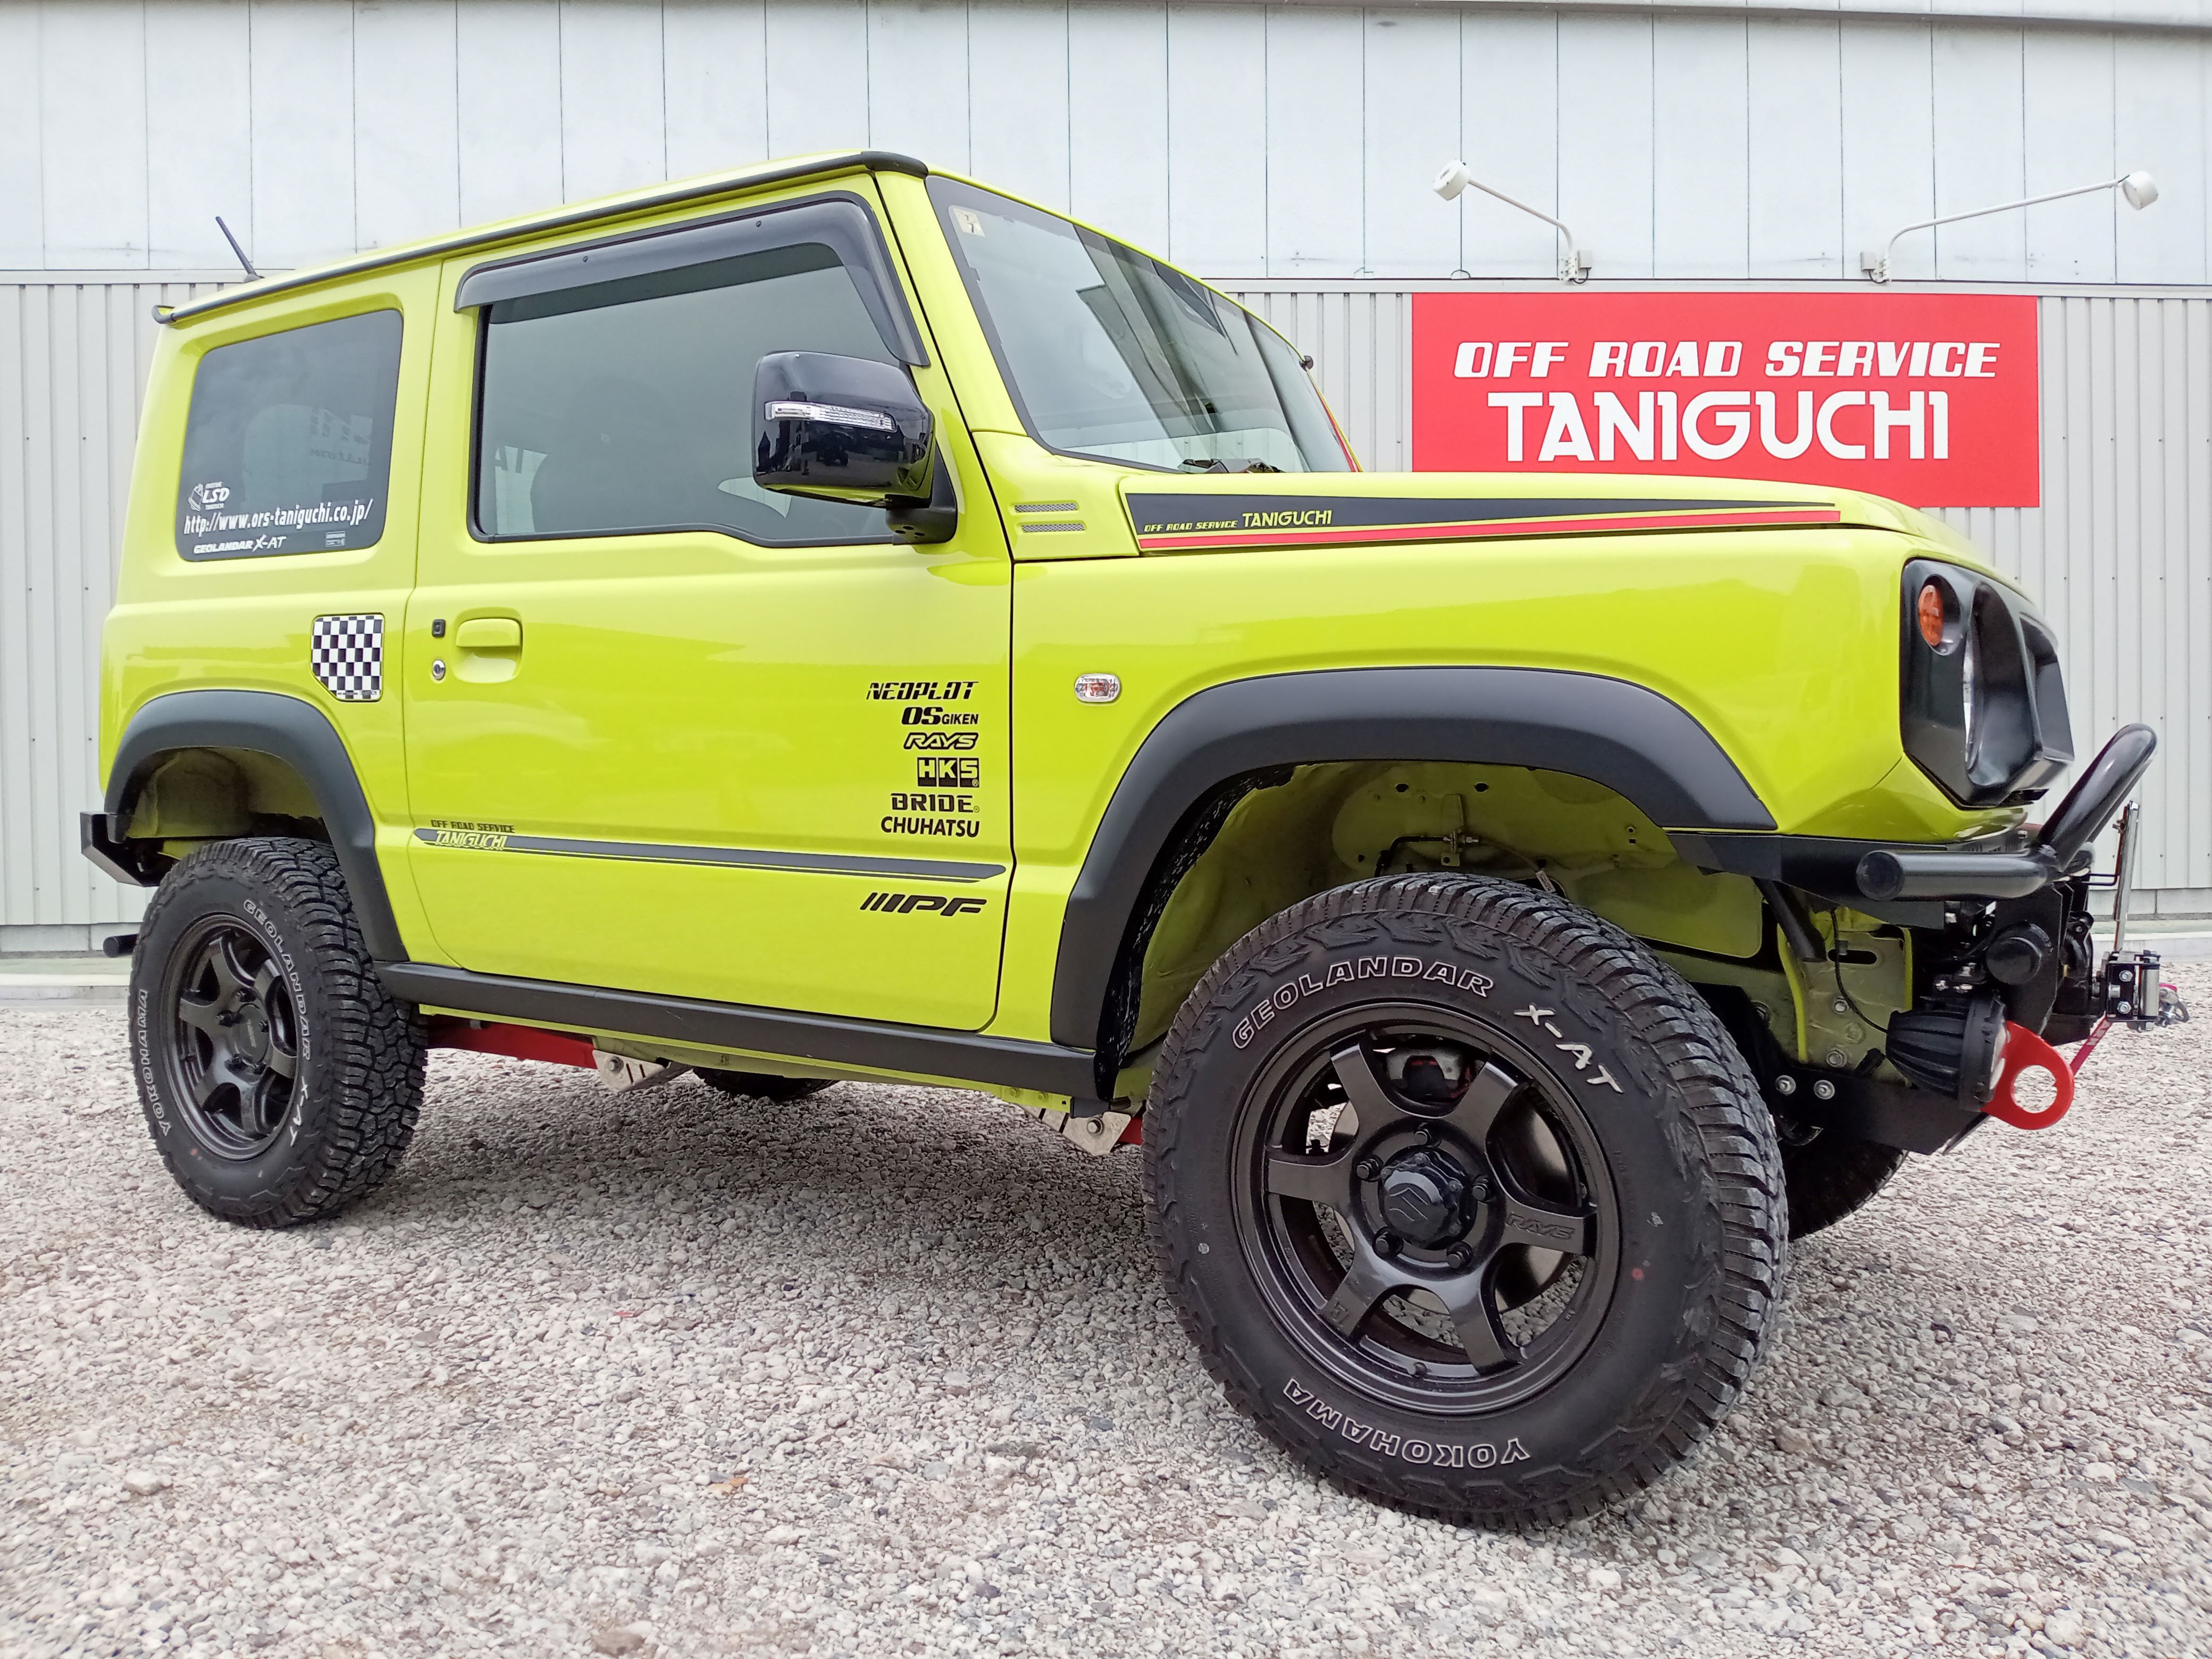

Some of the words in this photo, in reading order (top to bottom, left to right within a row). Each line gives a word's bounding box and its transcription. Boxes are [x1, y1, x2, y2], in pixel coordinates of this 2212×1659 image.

[1454, 342, 1569, 378] OFF
[1588, 341, 1742, 377] ROAD
[1765, 341, 2000, 378] SERVICE
[1487, 391, 1948, 462] TANIGUCHI
[202, 488, 230, 503] LSD
[183, 498, 373, 537] http://www.ors-taniguchi.co.jp/
[1144, 524, 1163, 532] OFF
[1166, 522, 1193, 531] ROAD
[1195, 520, 1238, 530] SERVICE
[1242, 509, 1333, 527] TANIGUCHI
[193, 540, 252, 554] GEOLANDAR
[252, 534, 287, 552] X-AT
[903, 732, 979, 750] RAYS
[918, 758, 979, 784] HKS
[891, 793, 974, 813] BRIDE
[450, 821, 474, 830] ROAD
[477, 823, 515, 833] SERVICE
[881, 816, 980, 837] CHUHATSU
[434, 830, 508, 850] TANIGUCHI
[244, 899, 311, 1061] GEOLANDAR
[289, 1075, 309, 1147] X-AT
[1231, 956, 1495, 1050] GEOLANDAR
[1513, 1003, 1624, 1094] X-AT
[137, 988, 172, 1137] YOKOHAMA
[1283, 1376, 1531, 1469] YOKOHAMA
